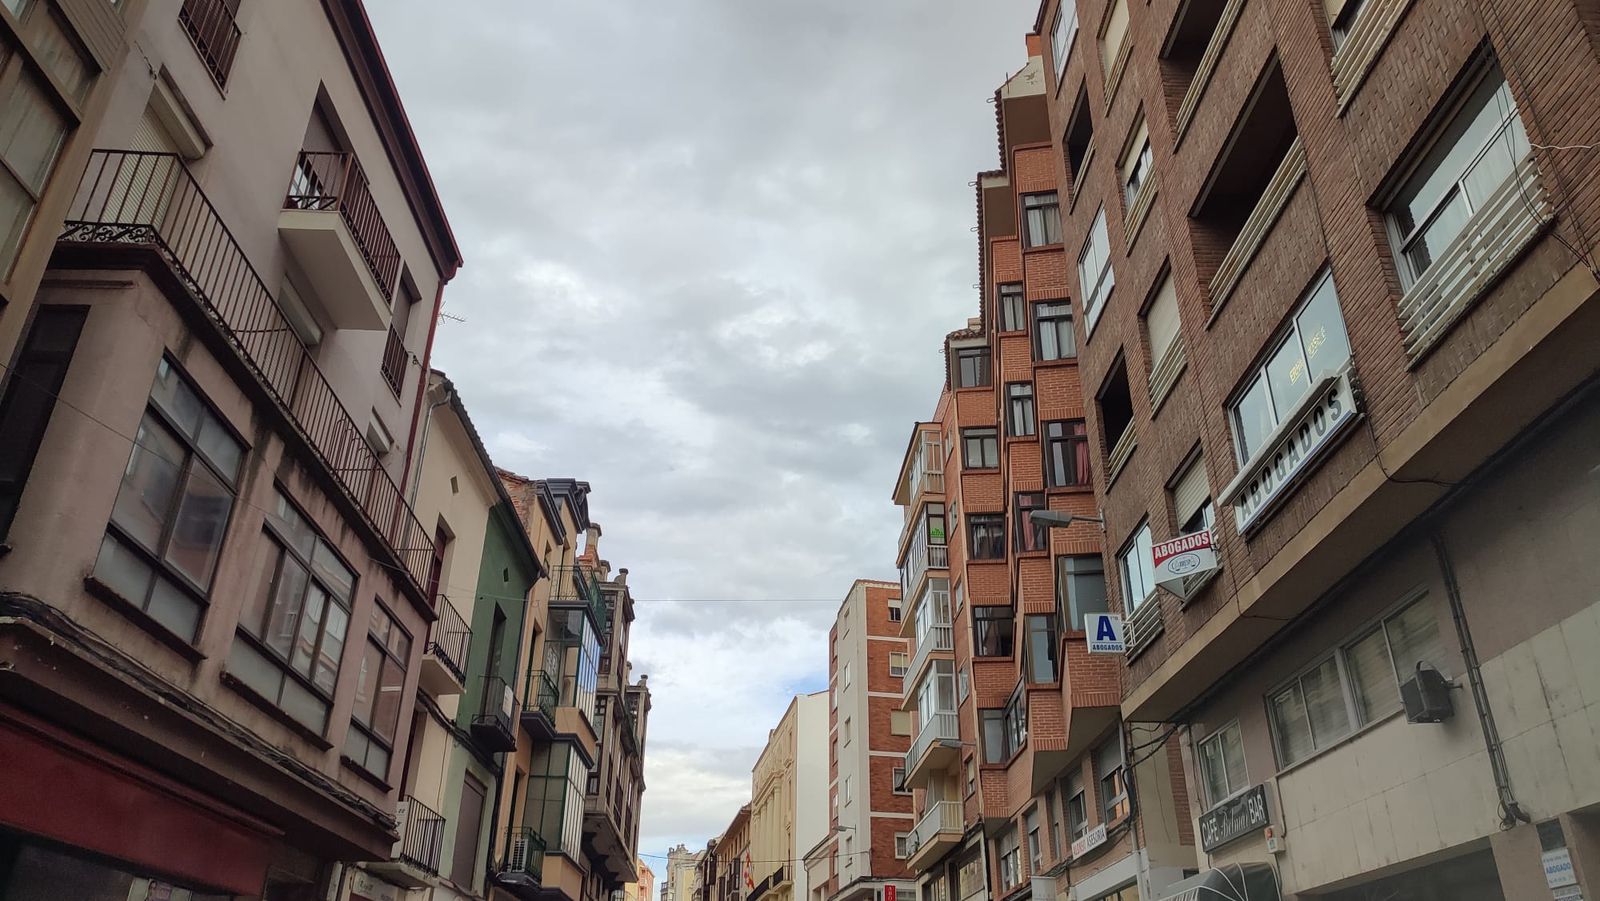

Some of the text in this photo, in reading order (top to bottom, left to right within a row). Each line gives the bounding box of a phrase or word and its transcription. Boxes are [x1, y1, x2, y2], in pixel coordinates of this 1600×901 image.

[1241, 388, 1343, 522] ABOGADOS
[1155, 532, 1209, 559] ABOGADOS
[1096, 615, 1117, 641] A
[1248, 794, 1266, 824] BAR
